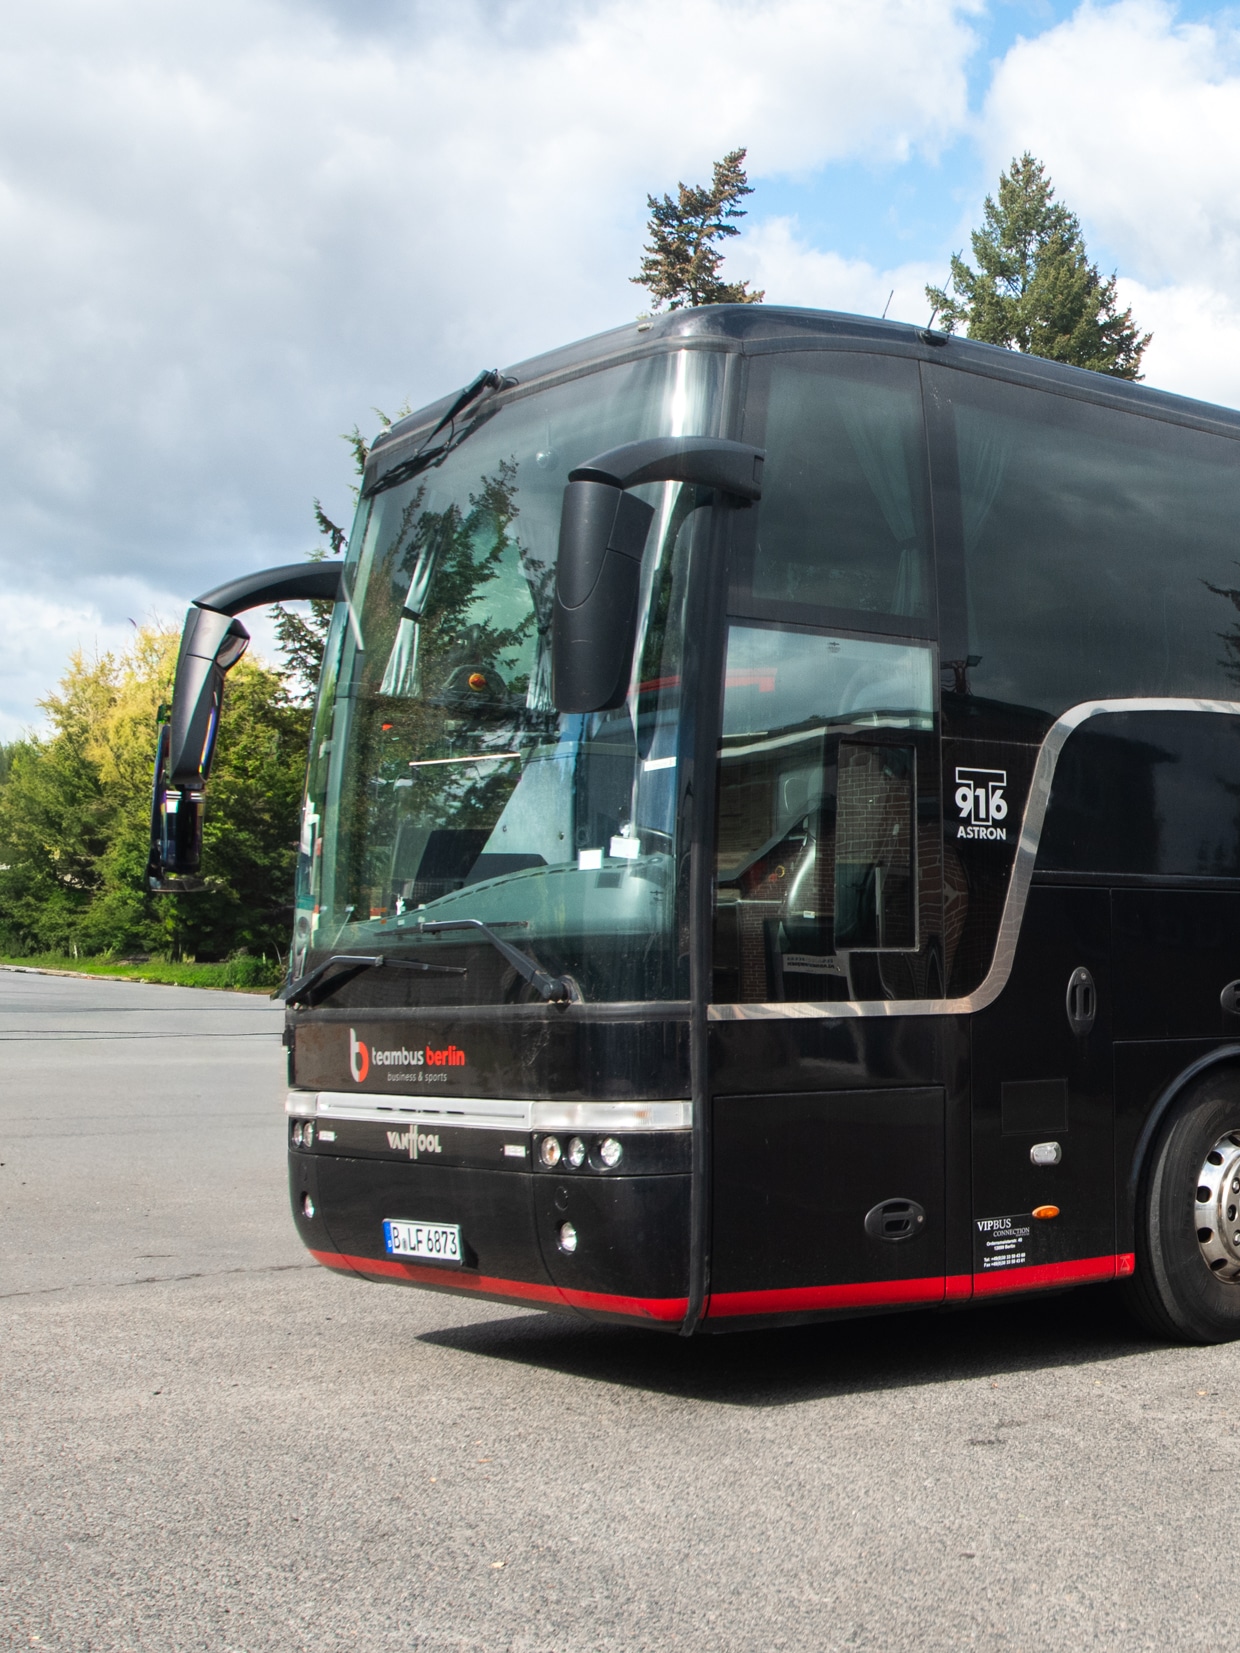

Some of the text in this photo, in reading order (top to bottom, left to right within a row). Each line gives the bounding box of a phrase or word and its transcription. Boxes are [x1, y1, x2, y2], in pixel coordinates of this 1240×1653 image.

[954, 786, 1008, 820] 916
[957, 825, 1007, 840] ASTRON
[371, 1046, 424, 1065] teambus
[425, 1045, 465, 1066] berlin
[387, 1071, 448, 1084] business & sports
[392, 1226, 458, 1255] B LF 6873
[993, 1227, 1030, 1237] CONNECTION
